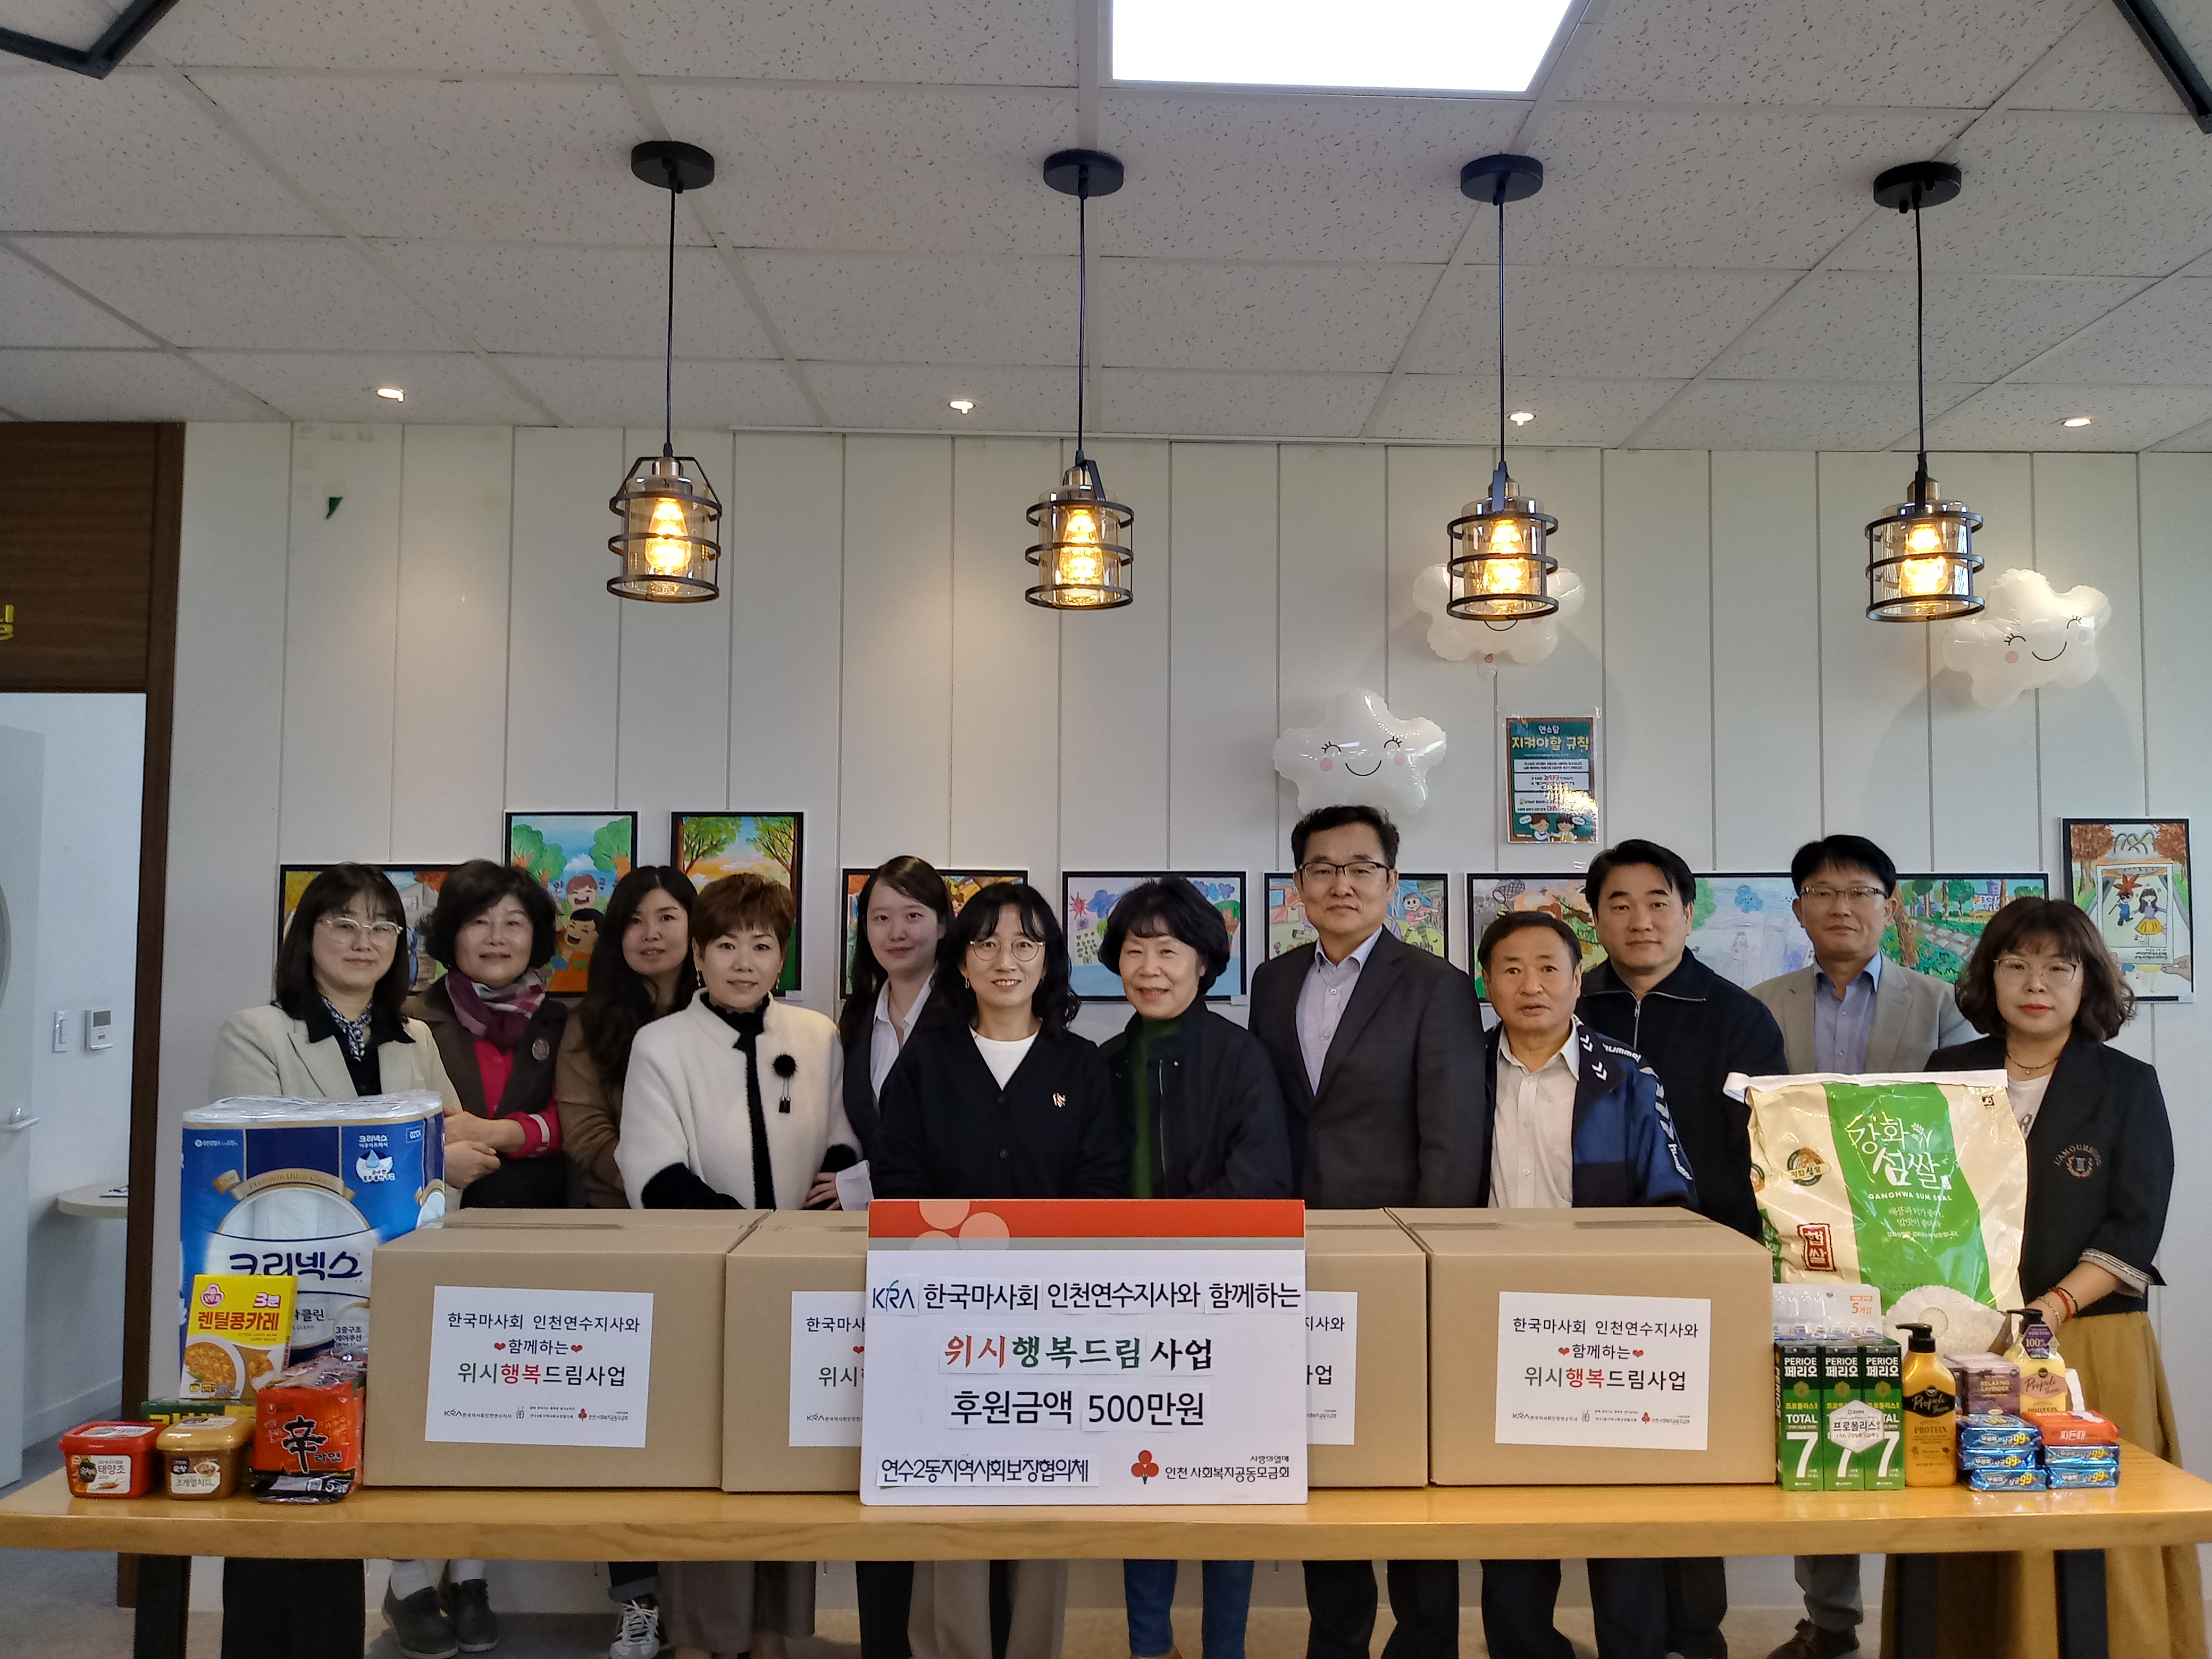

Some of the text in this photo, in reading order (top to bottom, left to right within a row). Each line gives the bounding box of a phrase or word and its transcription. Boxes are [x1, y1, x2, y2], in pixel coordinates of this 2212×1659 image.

[1512, 735, 1590, 751] 지켜야할 규칙
[1602, 1043, 1642, 1063] hummel
[1845, 1117, 1910, 1154] 강화
[1668, 1143, 1692, 1181] hummel
[1872, 1147, 1941, 1190] 섬쌀
[249, 1174, 285, 1189] Premium
[309, 1175, 334, 1186] Clean
[1868, 1191, 1914, 1200] GANGHWA
[229, 1250, 363, 1281] 크리넥스
[253, 1293, 281, 1309] 3분
[873, 1279, 1301, 1312] KRA 한국마사회 인천연수지사와 함께하는
[198, 1311, 280, 1330] 렌틸콩카레
[448, 1312, 640, 1333] 한국마사회 인천연수지사와
[1513, 1318, 1699, 1338] 한국마사회 인천연수지사와
[508, 1339, 569, 1355] 함께하는
[944, 1335, 1212, 1371] 위시행복드림 사업
[1572, 1344, 1631, 1360] 함께하는
[1784, 1357, 1817, 1365] PERIOE
[1825, 1357, 1858, 1365] PERIOE
[1866, 1357, 1899, 1365] PERIOE
[458, 1362, 625, 1387] 위시행복드림사업
[818, 1367, 865, 1387] 위시
[1524, 1367, 1686, 1391] 위시행복드림사업
[1784, 1365, 1818, 1377] 페리오
[1825, 1365, 1859, 1377] 페리오
[1866, 1365, 1900, 1377] 페리오
[951, 1390, 1204, 1426] 후원금액 500만원
[1786, 1414, 1818, 1423] TOTAL
[1833, 1421, 1876, 1431] 프로폴리스
[282, 1415, 329, 1475] 辛
[314, 1452, 343, 1463] 라면
[1250, 1455, 1289, 1464] 사랑의열매
[1787, 1431, 1819, 1478] 7
[1878, 1431, 1900, 1477] 7
[98, 1465, 126, 1475] 태양초
[881, 1459, 1088, 1482] 연수2동지역사회보장협의체
[1165, 1467, 1289, 1482] 인천 사회복지공동모금회
